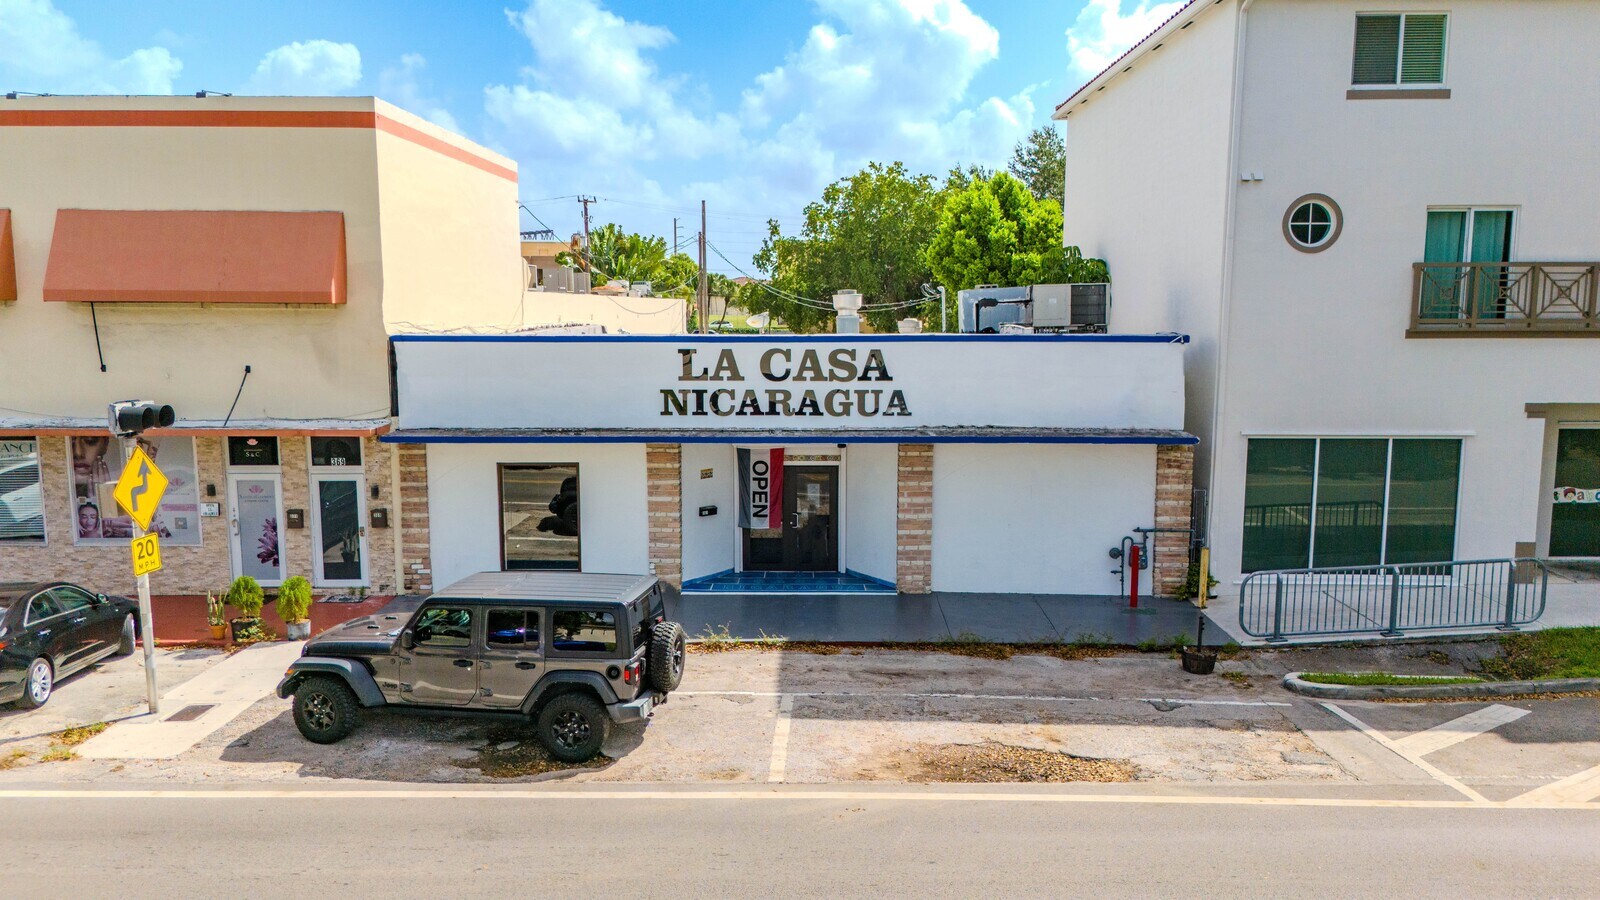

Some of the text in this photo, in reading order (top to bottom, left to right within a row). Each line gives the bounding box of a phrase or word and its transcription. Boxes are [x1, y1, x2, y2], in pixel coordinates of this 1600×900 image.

[678, 347, 894, 383] LA CASA
[659, 388, 913, 418] NICARAGUA
[331, 457, 346, 466] 369
[752, 460, 769, 518] OPEN
[136, 539, 155, 560] 20
[138, 559, 156, 570] MPH
[382, 681, 398, 689] Jeep
